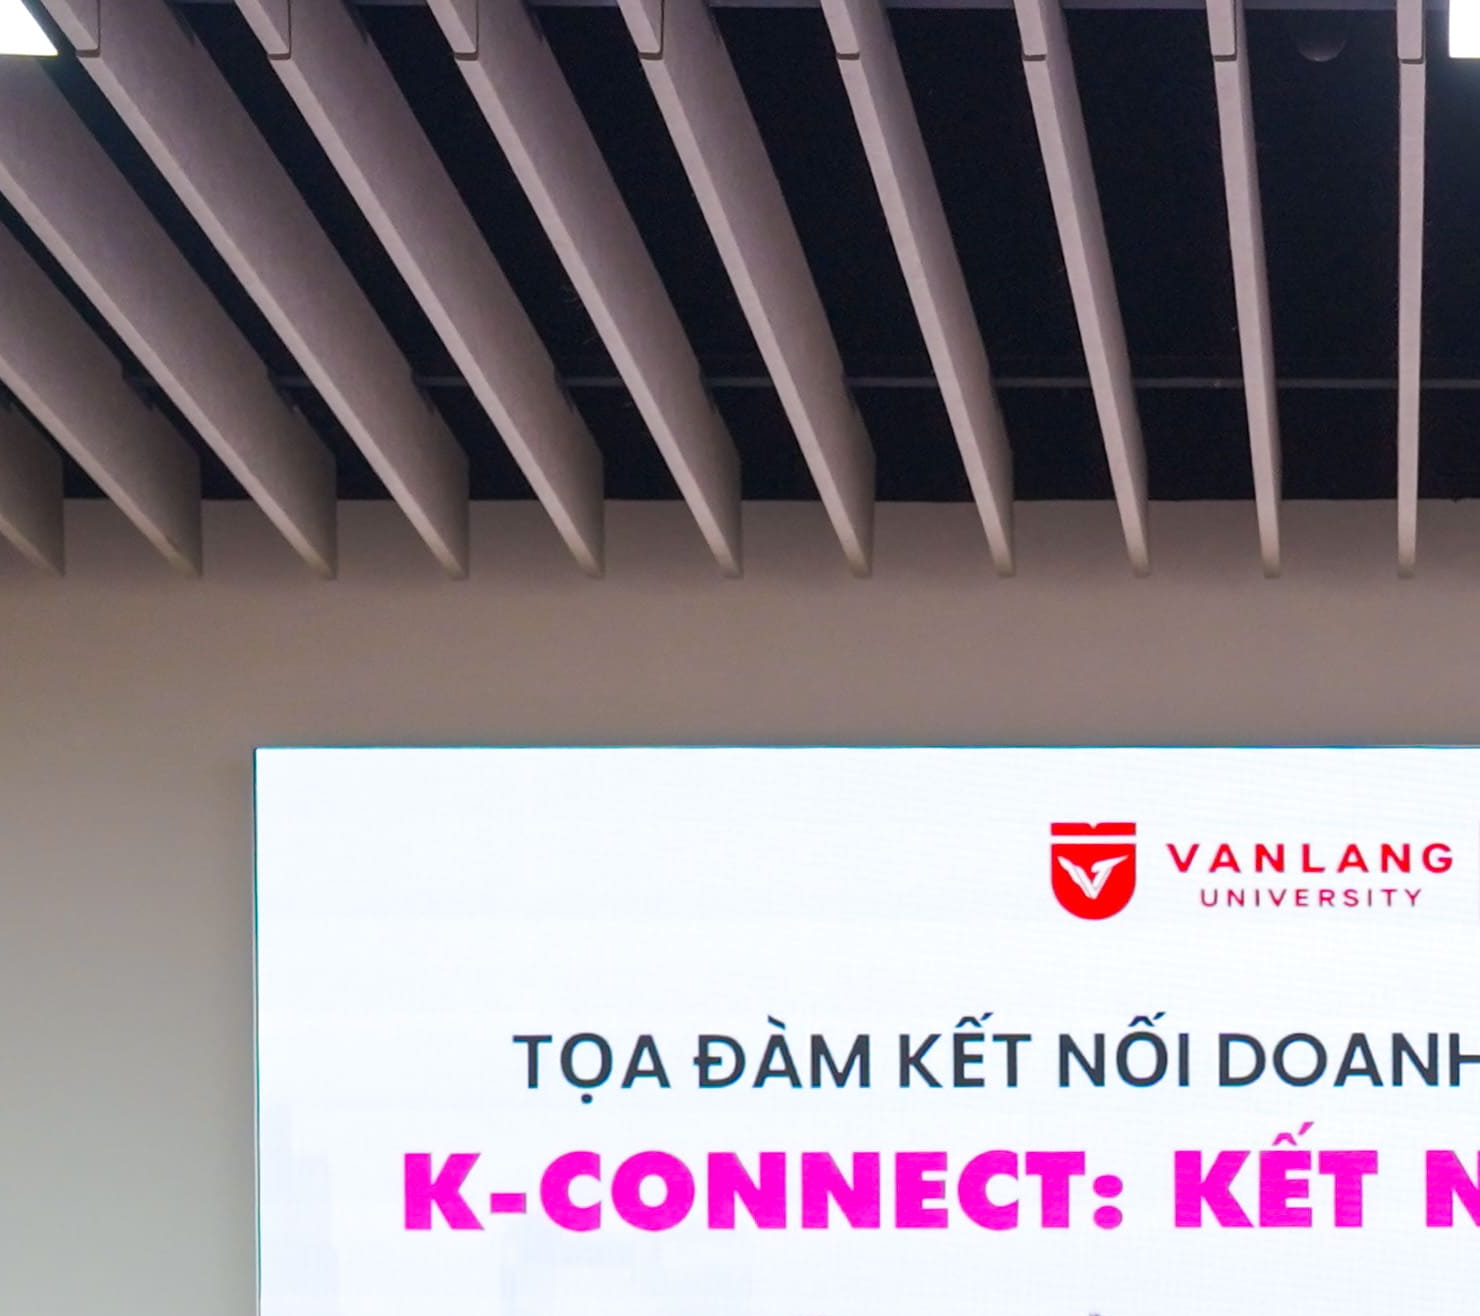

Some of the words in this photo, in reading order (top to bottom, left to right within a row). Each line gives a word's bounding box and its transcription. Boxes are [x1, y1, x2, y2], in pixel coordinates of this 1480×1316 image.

[1167, 843, 1452, 873] VANLANG
[1201, 889, 1421, 907] UNIVERSITY
[512, 1033, 671, 1104] TỌA
[693, 1015, 870, 1088] ĐÀM
[899, 1012, 1032, 1088] KẾT
[1059, 1012, 1189, 1088] NỐI
[404, 1150, 1123, 1232] K-CONNECT:
[1174, 1122, 1378, 1228] KẾT
